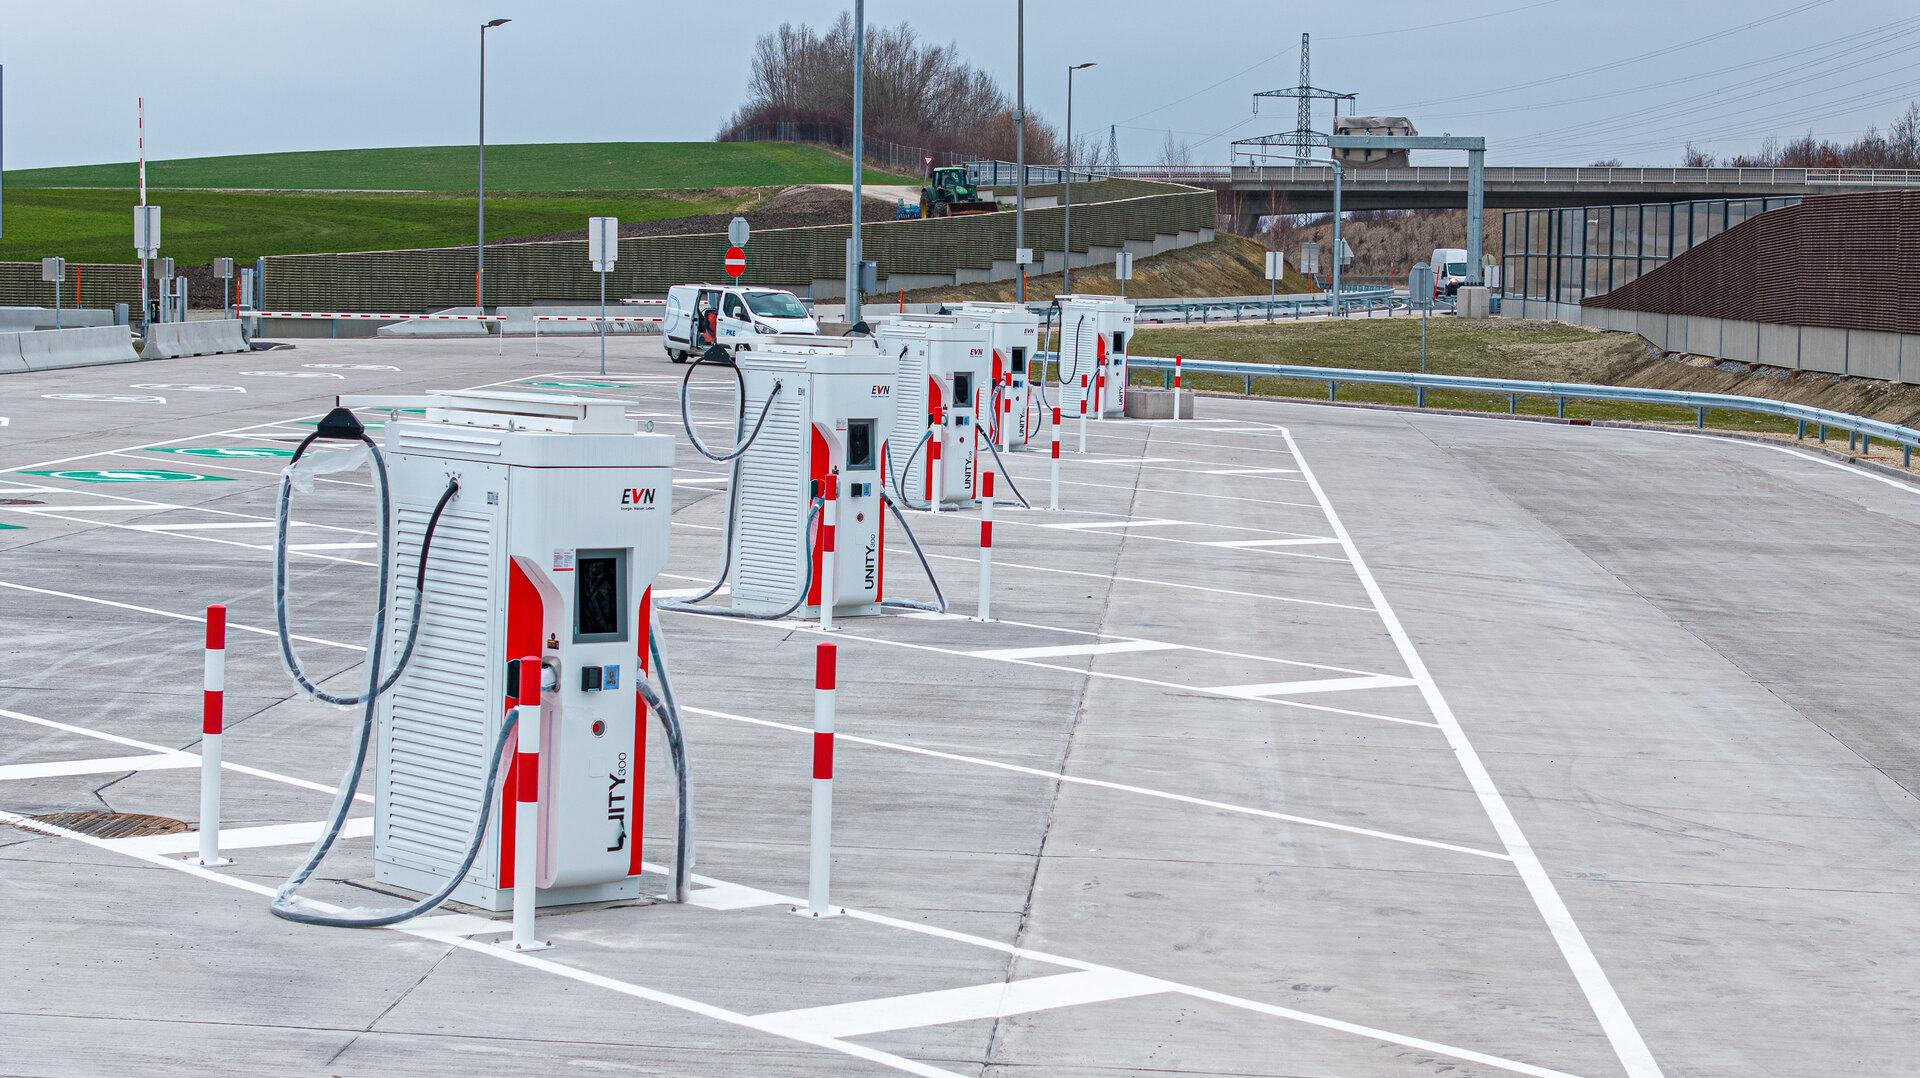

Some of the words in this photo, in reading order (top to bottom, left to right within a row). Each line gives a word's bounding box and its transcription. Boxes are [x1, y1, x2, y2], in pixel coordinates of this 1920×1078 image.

[871, 385, 890, 395] EVN
[964, 458, 972, 489] UNITY
[621, 488, 656, 504] EVN
[864, 545, 875, 590] UNITY
